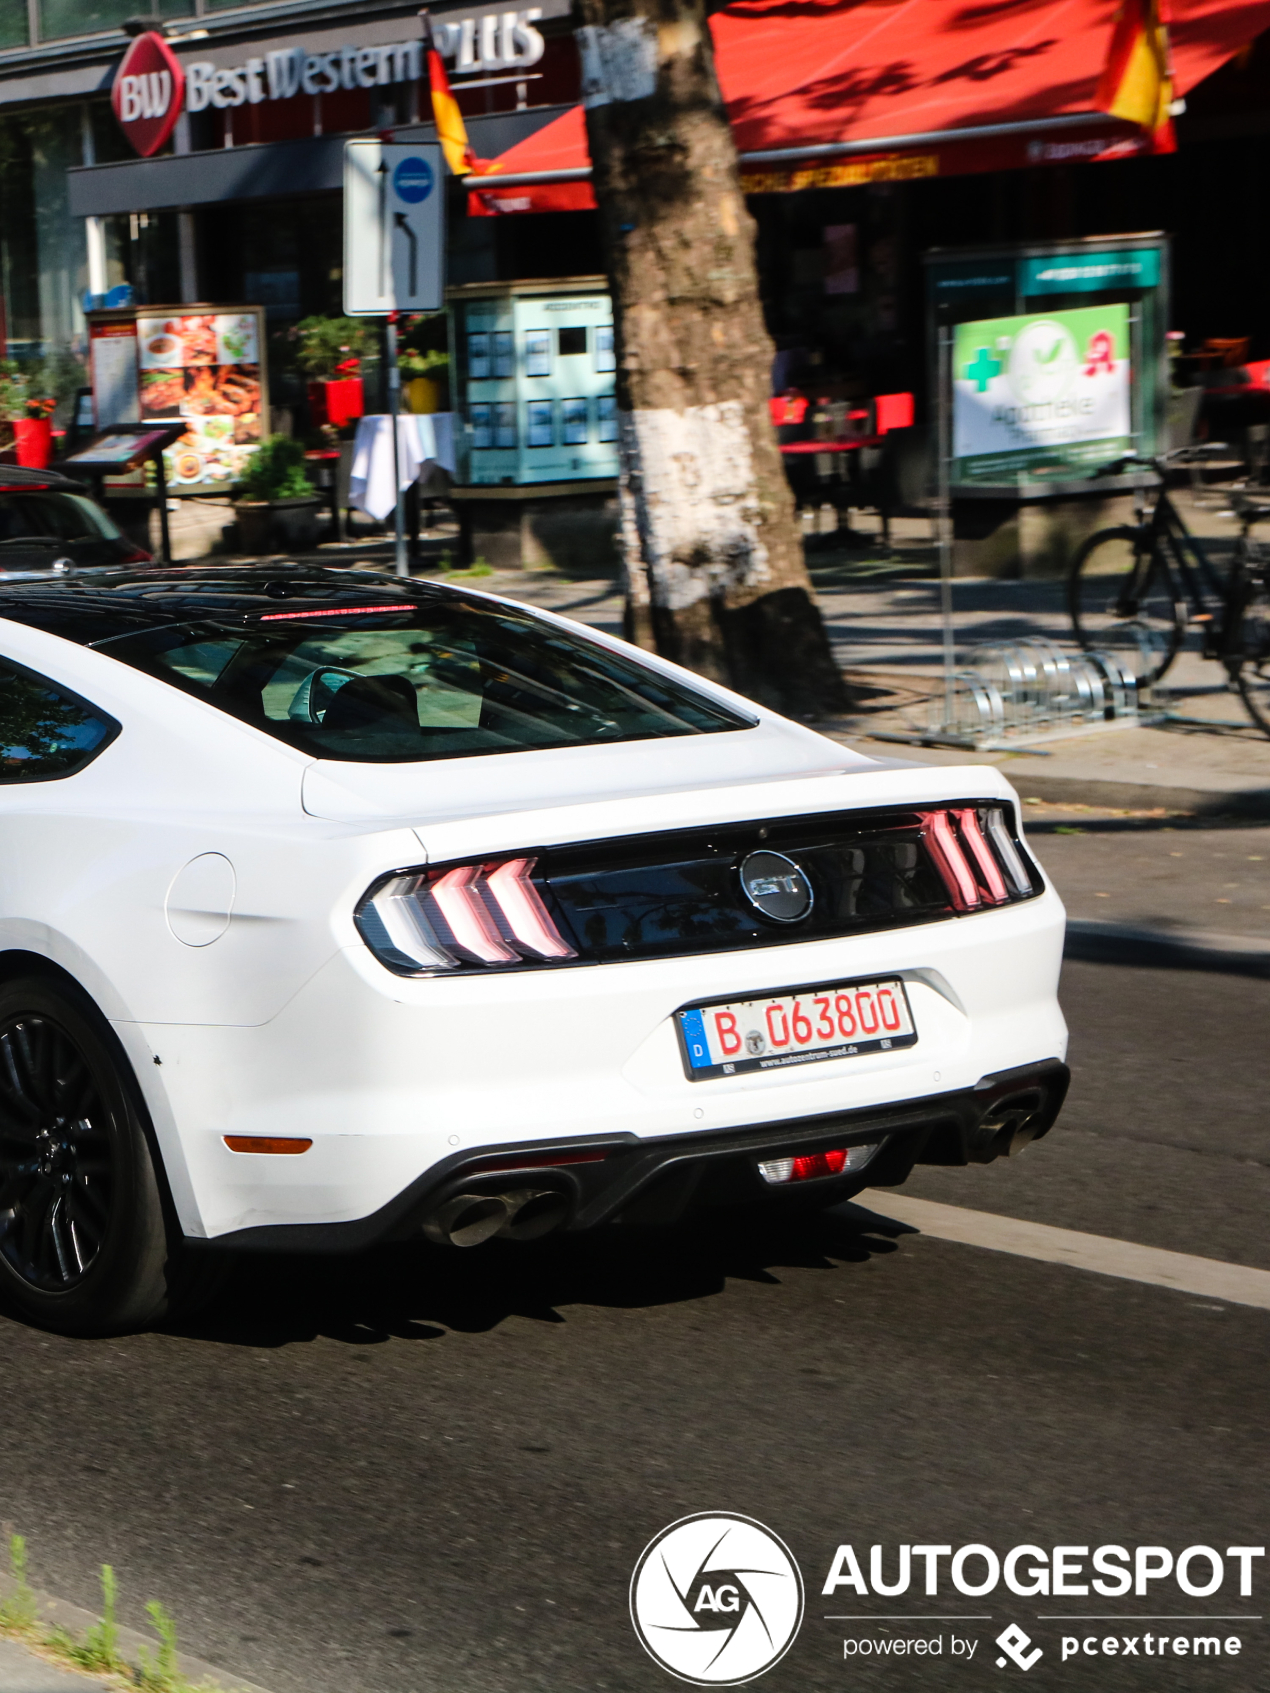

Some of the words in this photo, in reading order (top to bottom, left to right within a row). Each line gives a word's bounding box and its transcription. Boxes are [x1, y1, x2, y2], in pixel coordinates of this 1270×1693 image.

[120, 70, 171, 122] BW
[186, 57, 266, 112] Best
[266, 40, 425, 100] Western
[750, 874, 799, 896] GT
[714, 1012, 742, 1056] B
[765, 989, 901, 1047] 063800
